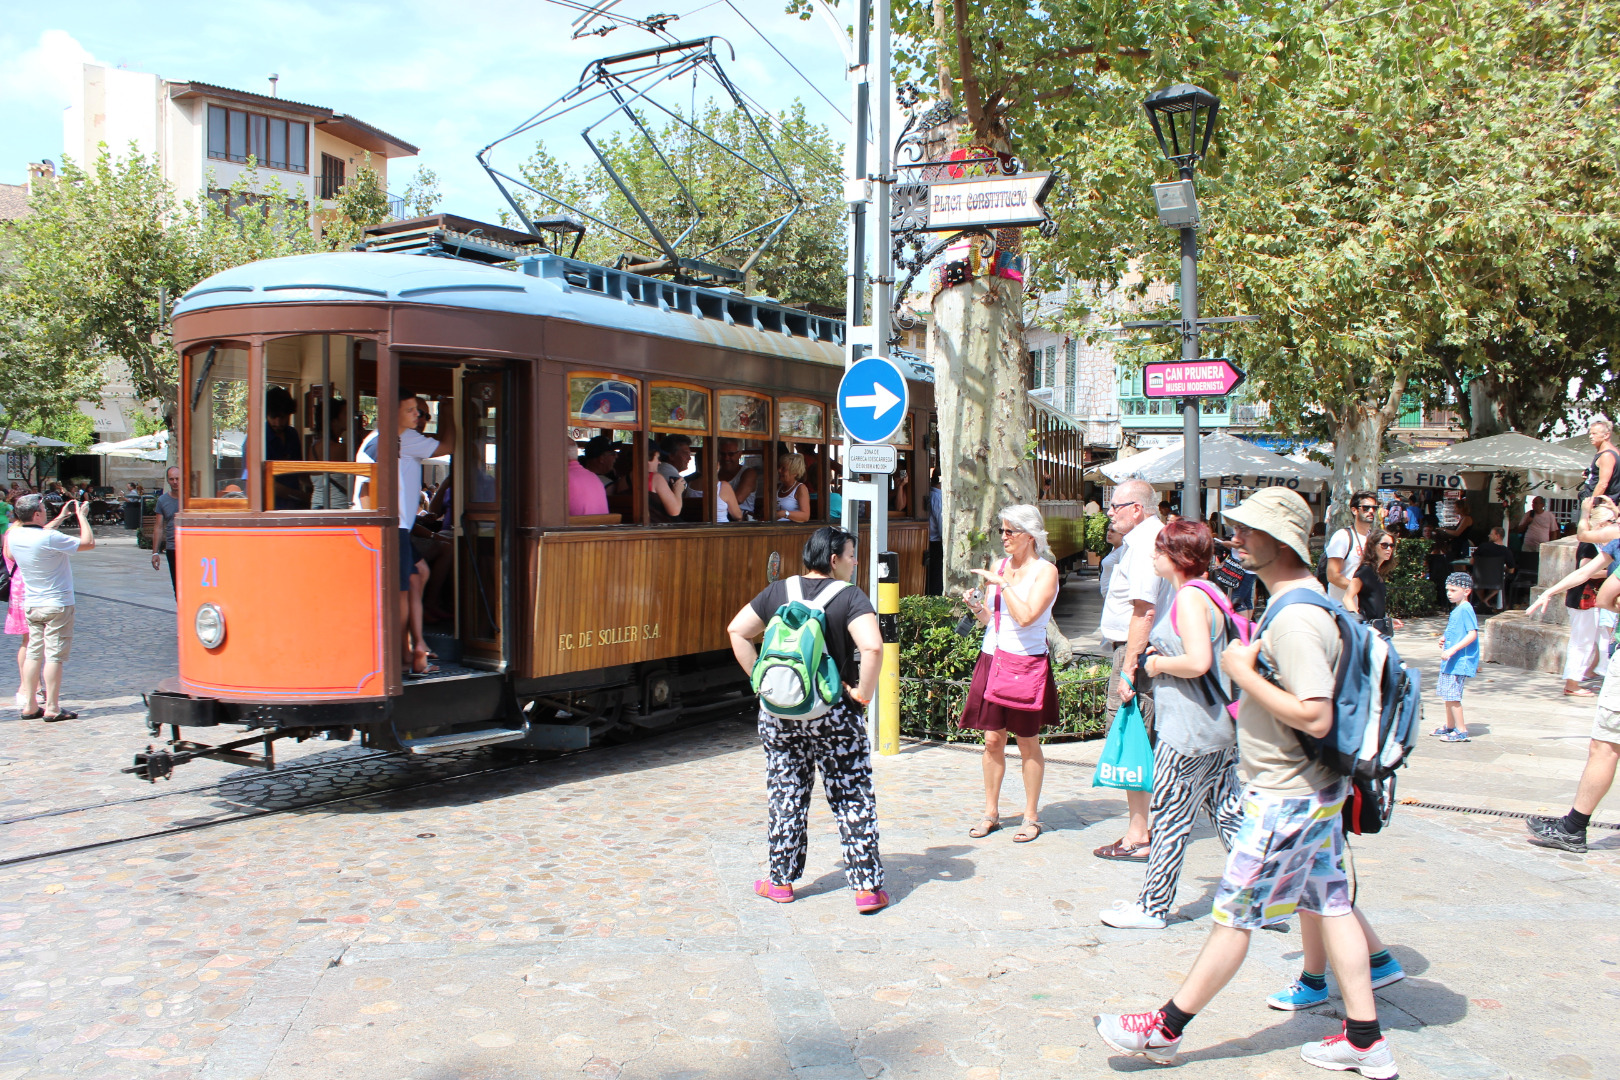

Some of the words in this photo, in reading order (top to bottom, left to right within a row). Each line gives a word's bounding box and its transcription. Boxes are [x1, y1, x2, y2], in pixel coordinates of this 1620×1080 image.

[933, 194, 962, 214] PLAÇA
[966, 187, 1028, 211] CONSTITUCIÓ
[1165, 367, 1182, 381] CAN
[1184, 365, 1225, 380] PRUNERA
[1165, 382, 1186, 392] MUSEU
[1187, 381, 1225, 391] MODERNISTA
[1175, 479, 1207, 490] BR
[1220, 475, 1243, 487] ES
[1256, 475, 1300, 490] FIRÓ
[1380, 471, 1404, 485] ES
[200, 557, 218, 587] 21
[578, 630, 593, 648] DE
[598, 625, 638, 646] SOLLER
[642, 623, 661, 640] S.A.
